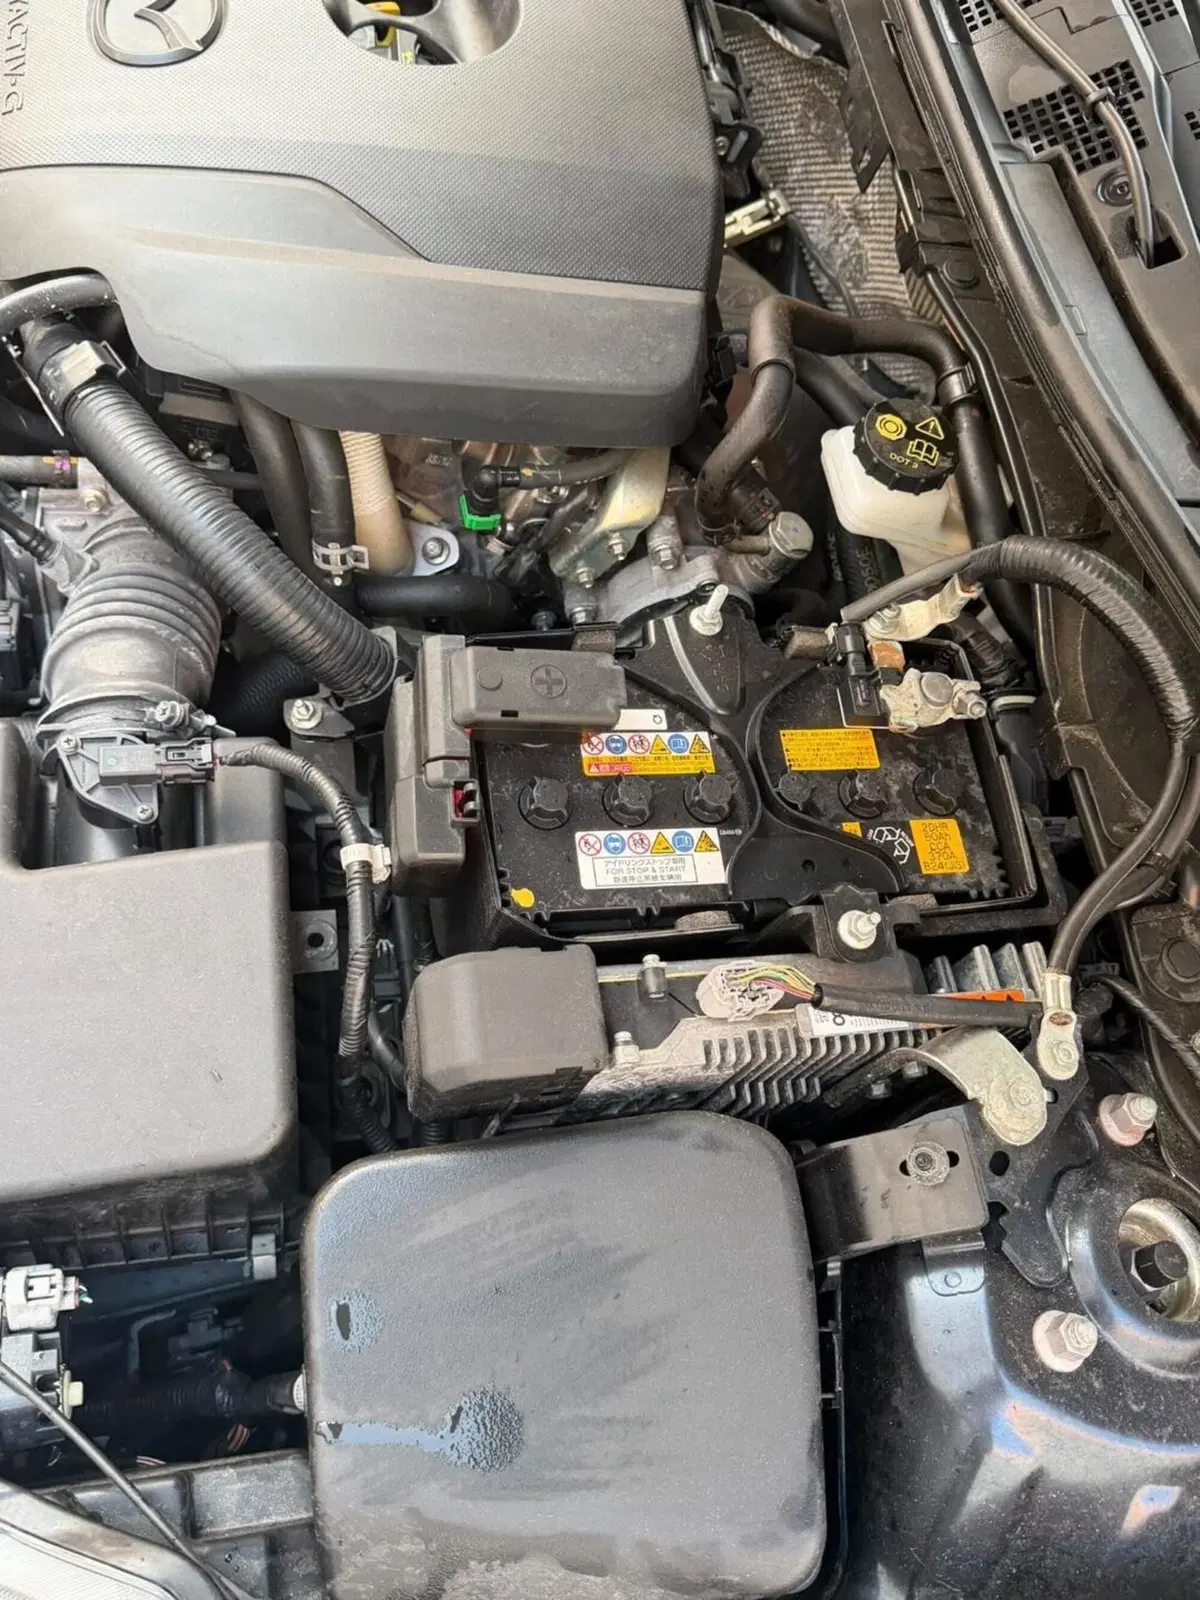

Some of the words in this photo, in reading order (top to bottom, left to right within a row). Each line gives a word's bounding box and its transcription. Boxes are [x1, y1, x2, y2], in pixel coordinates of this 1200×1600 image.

[889, 452, 912, 466] DOT
[911, 461, 919, 469] 3
[929, 842, 951, 852] CCA
[928, 851, 957, 861] 370A
[605, 867, 624, 875] FOR
[626, 866, 649, 874] STOP
[659, 865, 686, 873] START
